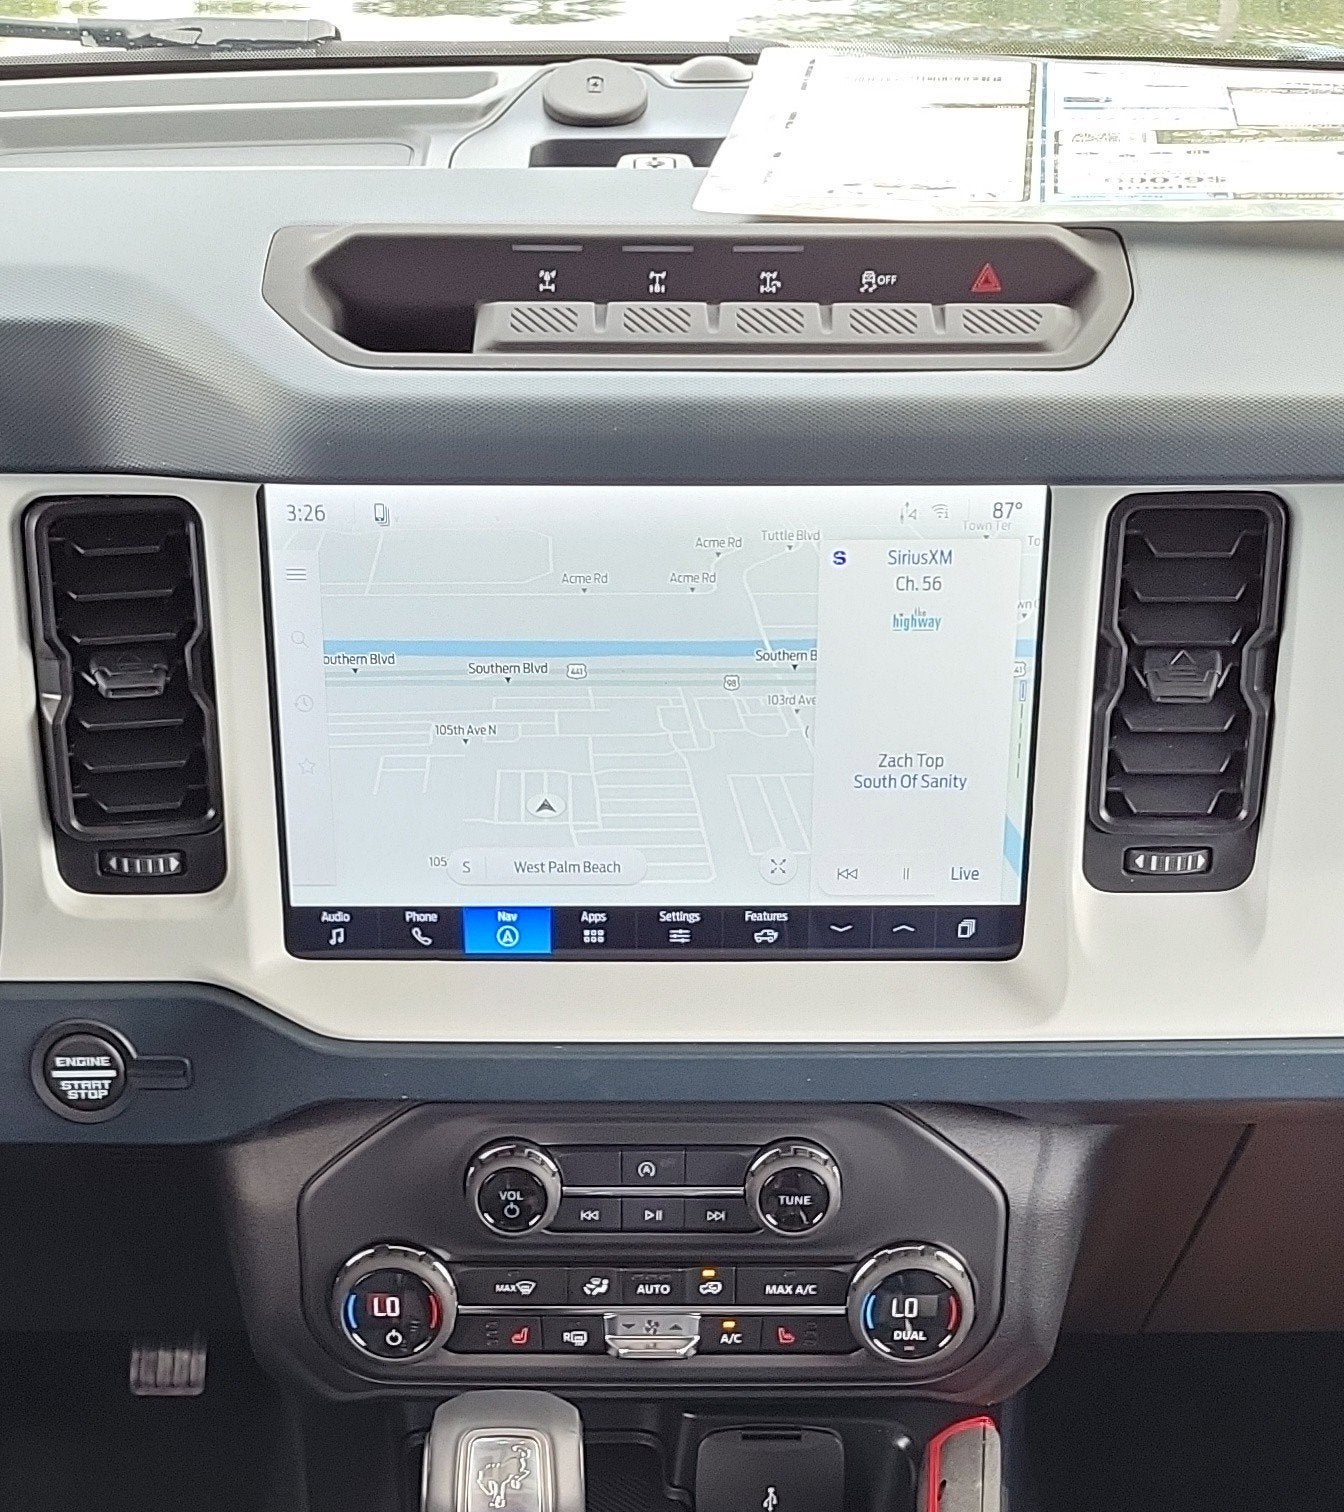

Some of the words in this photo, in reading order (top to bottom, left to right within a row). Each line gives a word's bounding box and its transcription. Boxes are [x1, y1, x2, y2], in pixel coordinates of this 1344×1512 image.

[877, 274, 898, 285] OFF
[286, 503, 326, 522] 3:26
[992, 502, 1023, 519] 87°
[963, 520, 992, 531] Town
[761, 529, 794, 541] Tuttle
[796, 529, 821, 541] Blvd
[695, 537, 726, 549] Acme
[727, 537, 742, 549] Rd
[887, 550, 953, 566] SiriusXM
[561, 572, 592, 584] Acme
[594, 572, 608, 584] Rd
[669, 572, 700, 584] Acme
[701, 572, 716, 584] Rd
[895, 576, 919, 592] Ch.
[922, 576, 942, 592] 56
[892, 613, 942, 632] highway
[323, 654, 367, 665] outhern
[370, 653, 395, 665] Blvd
[755, 649, 808, 662] Southern
[467, 662, 521, 675] Southern
[523, 662, 549, 675] Blvd
[767, 694, 796, 706] 103rd
[435, 724, 465, 736] 105th
[466, 724, 487, 736] Ave
[488, 724, 497, 736] N
[878, 752, 913, 768] Zach
[916, 752, 945, 770] Top
[854, 773, 897, 789] South
[900, 773, 919, 789] Of
[920, 773, 967, 791] Sanity
[462, 860, 472, 873] S
[513, 860, 546, 873] West
[548, 860, 581, 873] Palm
[582, 860, 621, 873] Beach
[950, 866, 980, 881] Live
[321, 911, 351, 922] Audio
[405, 911, 438, 922] Phone
[497, 911, 518, 922] Nav
[580, 911, 607, 924] Apps
[658, 911, 701, 924] Settings
[745, 911, 788, 922] Features
[55, 1056, 112, 1067] ENGINE
[59, 1080, 112, 1090] START
[66, 1090, 109, 1100] STOP
[499, 1190, 524, 1201] VOL
[778, 1195, 813, 1206] TUNE
[496, 1283, 516, 1293] MAX
[636, 1284, 671, 1295] AUTO
[765, 1284, 794, 1295] MAX
[796, 1284, 817, 1296] A/C
[373, 1296, 401, 1317] LO
[892, 1297, 918, 1318] LO
[720, 1333, 742, 1345] A/C
[893, 1330, 927, 1341] DUAL
